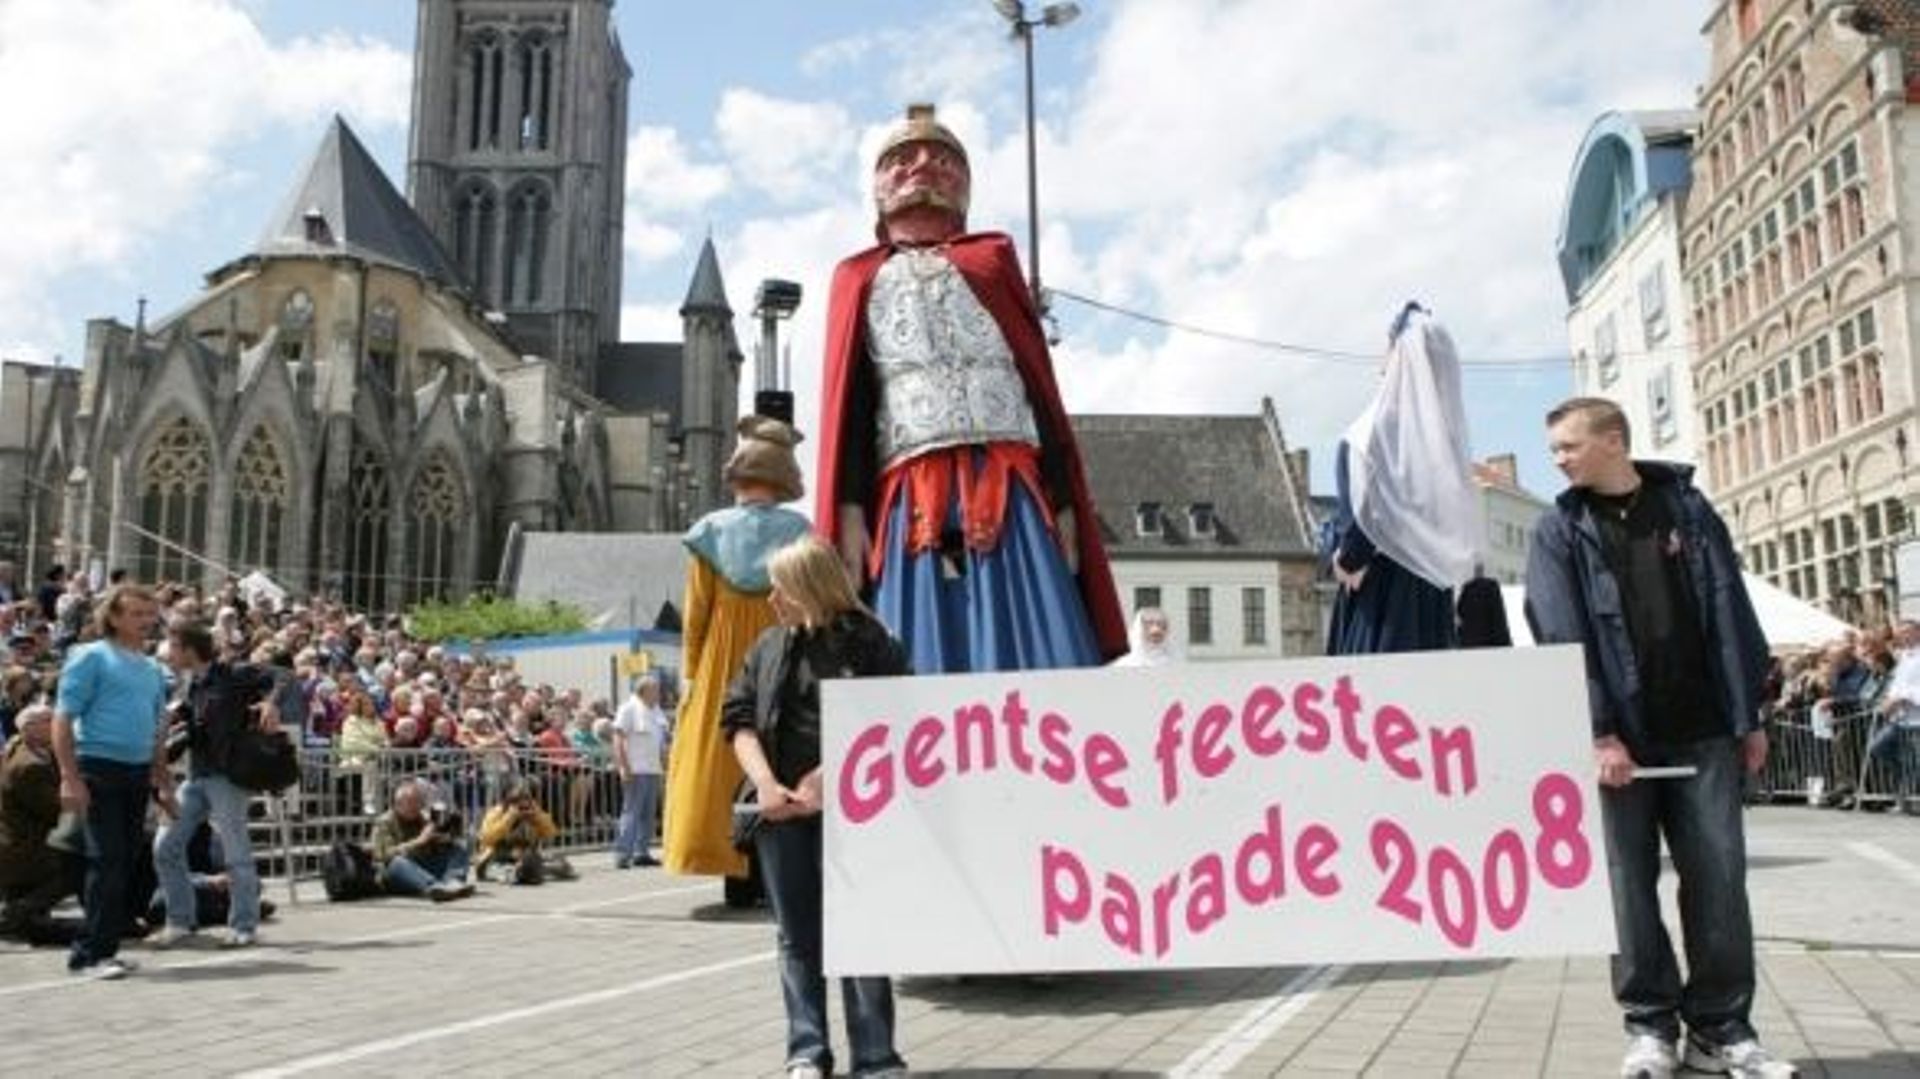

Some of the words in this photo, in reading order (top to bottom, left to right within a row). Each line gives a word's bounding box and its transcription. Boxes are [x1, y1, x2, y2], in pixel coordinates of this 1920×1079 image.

[839, 691, 1129, 825] Gentse
[1155, 676, 1477, 802] feesten
[1041, 805, 1341, 957] parade
[1370, 773, 1593, 949] 2008
